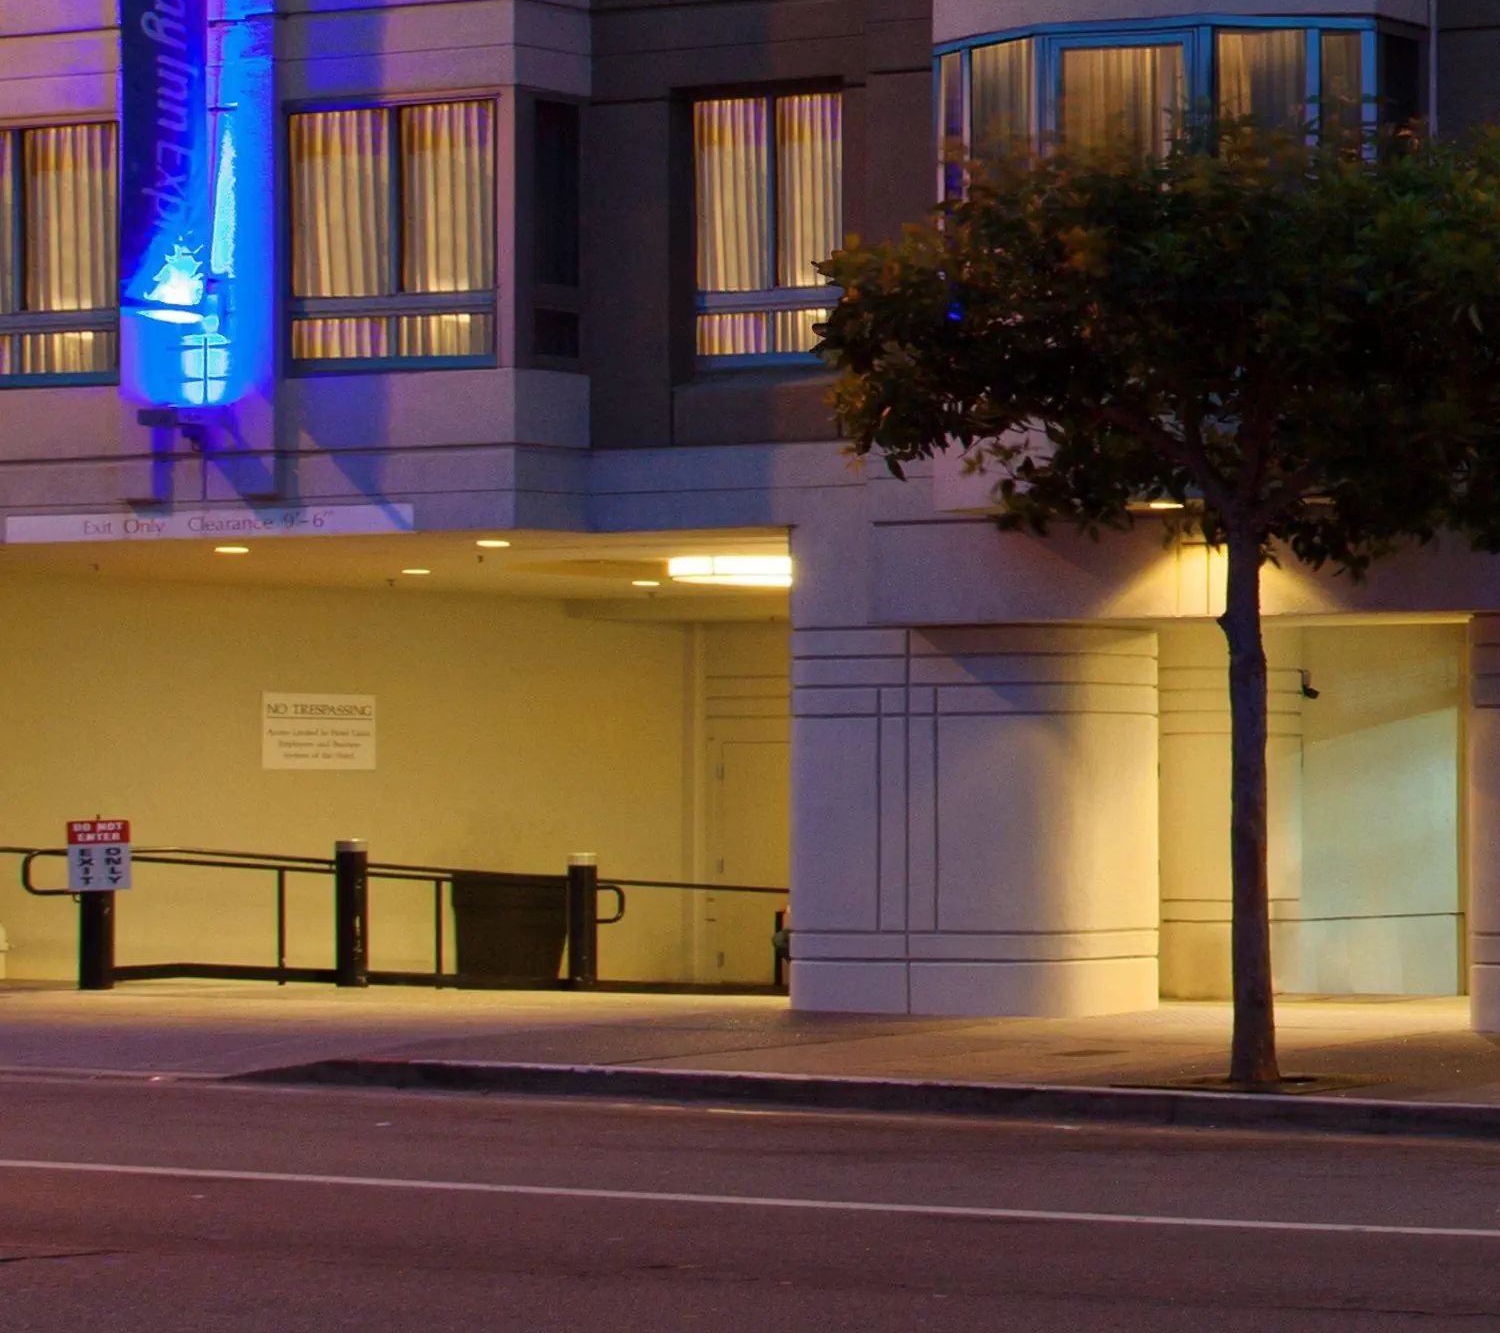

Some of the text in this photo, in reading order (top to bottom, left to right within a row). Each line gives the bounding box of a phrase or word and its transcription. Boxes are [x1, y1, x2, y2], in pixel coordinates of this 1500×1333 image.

[157, 54, 199, 132] Inn
[84, 519, 112, 534] Exit
[123, 518, 165, 536] Only
[187, 515, 274, 533] Clearance
[267, 703, 373, 716] NO TRESPASSING
[72, 821, 123, 833] DO NOT
[76, 832, 121, 843] ENTER
[78, 847, 95, 885] EXIT
[104, 846, 123, 885] ONLY
